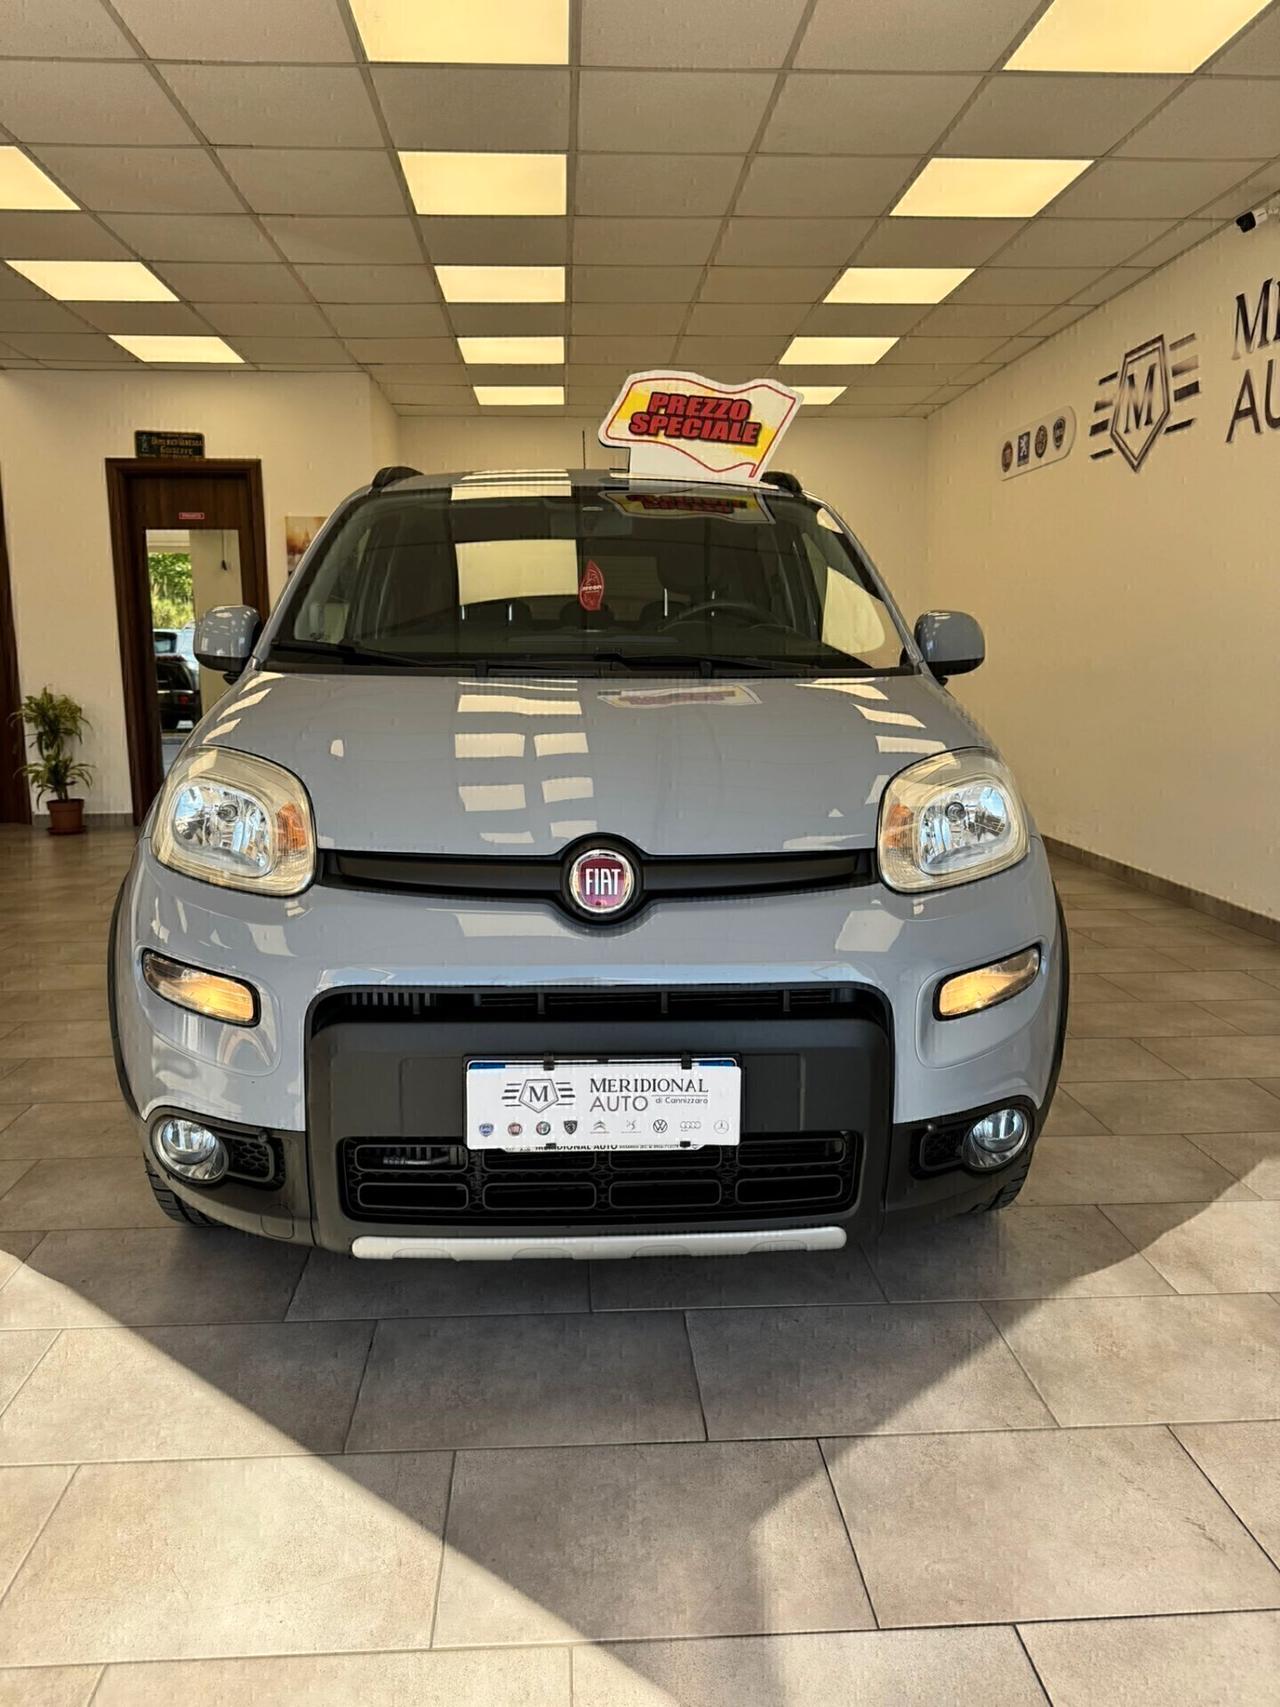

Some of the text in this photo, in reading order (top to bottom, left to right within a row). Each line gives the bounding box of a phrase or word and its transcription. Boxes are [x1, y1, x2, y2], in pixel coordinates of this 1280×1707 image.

[1231, 277, 1280, 360] M
[647, 391, 752, 422] PREZZO
[1124, 363, 1157, 434] M
[628, 411, 762, 446] SPECIALE
[585, 868, 621, 895] FIAT
[529, 1086, 548, 1102] M
[590, 1078, 709, 1093] MERIDIONAL
[590, 1095, 649, 1112] AUTO
[665, 1097, 709, 1105] Cannizzaro
